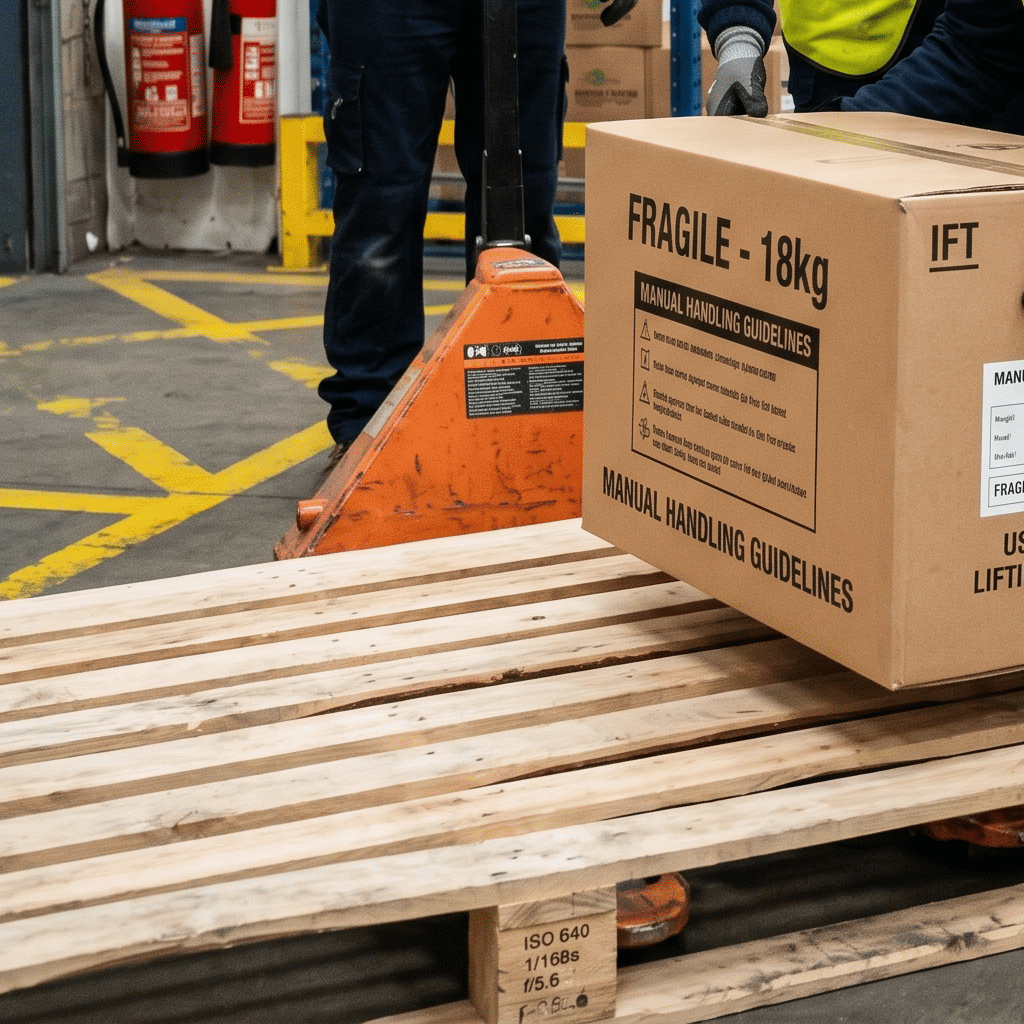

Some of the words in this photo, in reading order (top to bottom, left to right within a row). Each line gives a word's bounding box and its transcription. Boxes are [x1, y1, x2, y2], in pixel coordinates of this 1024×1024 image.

[627, 192, 731, 270] FRAGILE
[760, 230, 829, 311] 18kg
[930, 221, 980, 262] IFT
[639, 280, 684, 315] MANUAL
[686, 295, 741, 335] HANDLING
[743, 314, 813, 358] GUIDELINES
[602, 465, 662, 522] MANUAL
[665, 496, 746, 562] HANDLING
[749, 536, 854, 613] GUIDELINES
[524, 931, 555, 951] ISO
[559, 923, 590, 943] 640
[523, 972, 560, 994] f/5.6
